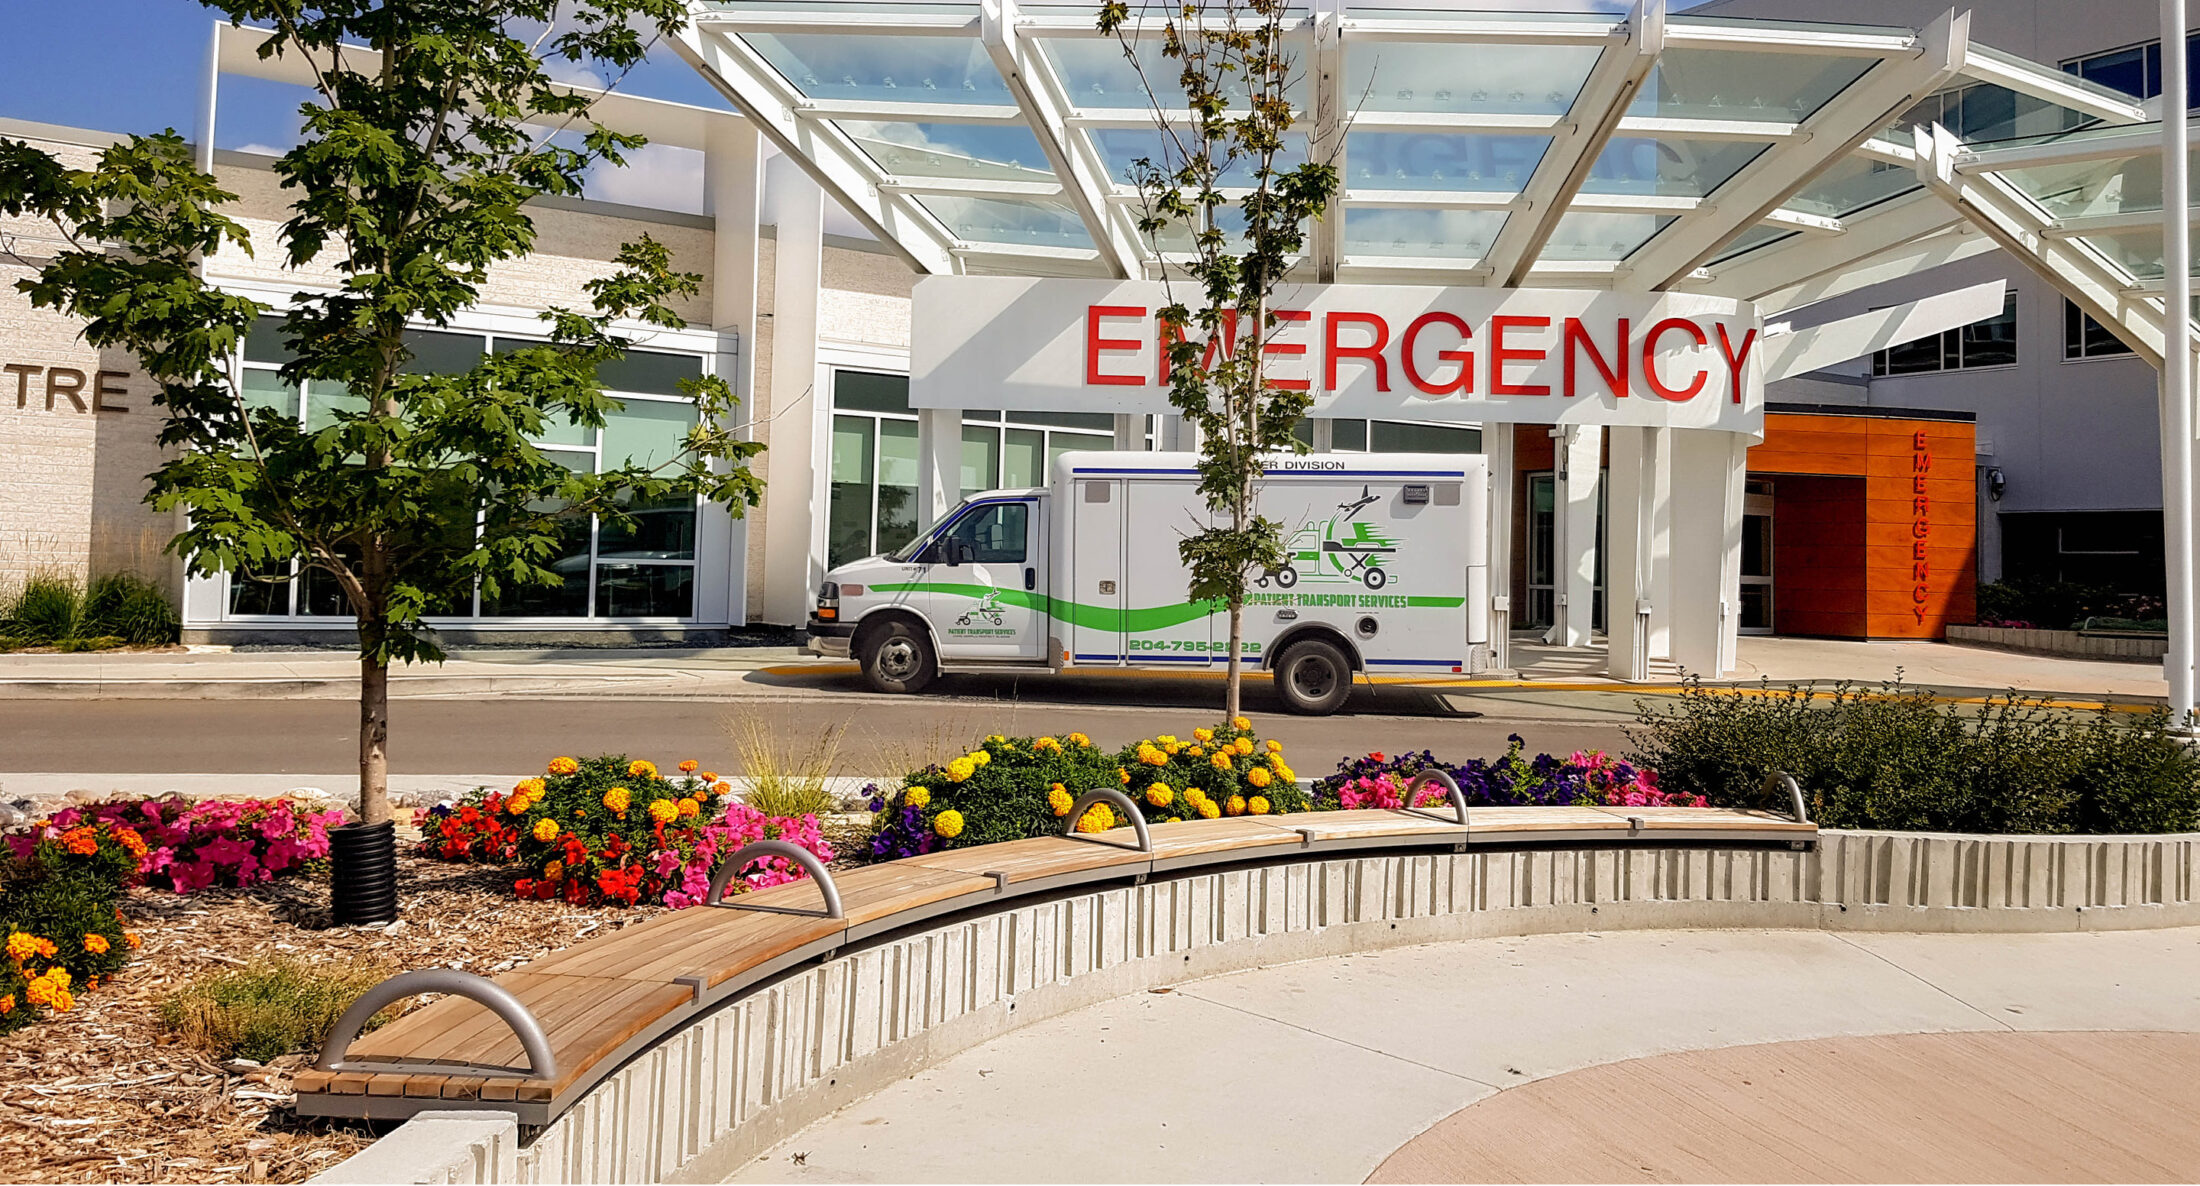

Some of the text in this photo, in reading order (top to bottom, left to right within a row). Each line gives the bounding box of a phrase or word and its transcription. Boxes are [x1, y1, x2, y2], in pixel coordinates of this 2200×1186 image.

[1087, 305, 1757, 404] EMERGENCY
[4, 363, 130, 414] TRE
[1285, 461, 1345, 470] DIVISION
[1913, 430, 1932, 625] EMERGENCY
[1254, 593, 1407, 609] PATIENT TRANSPORT SERVICES
[994, 628, 1016, 636] SERVICES
